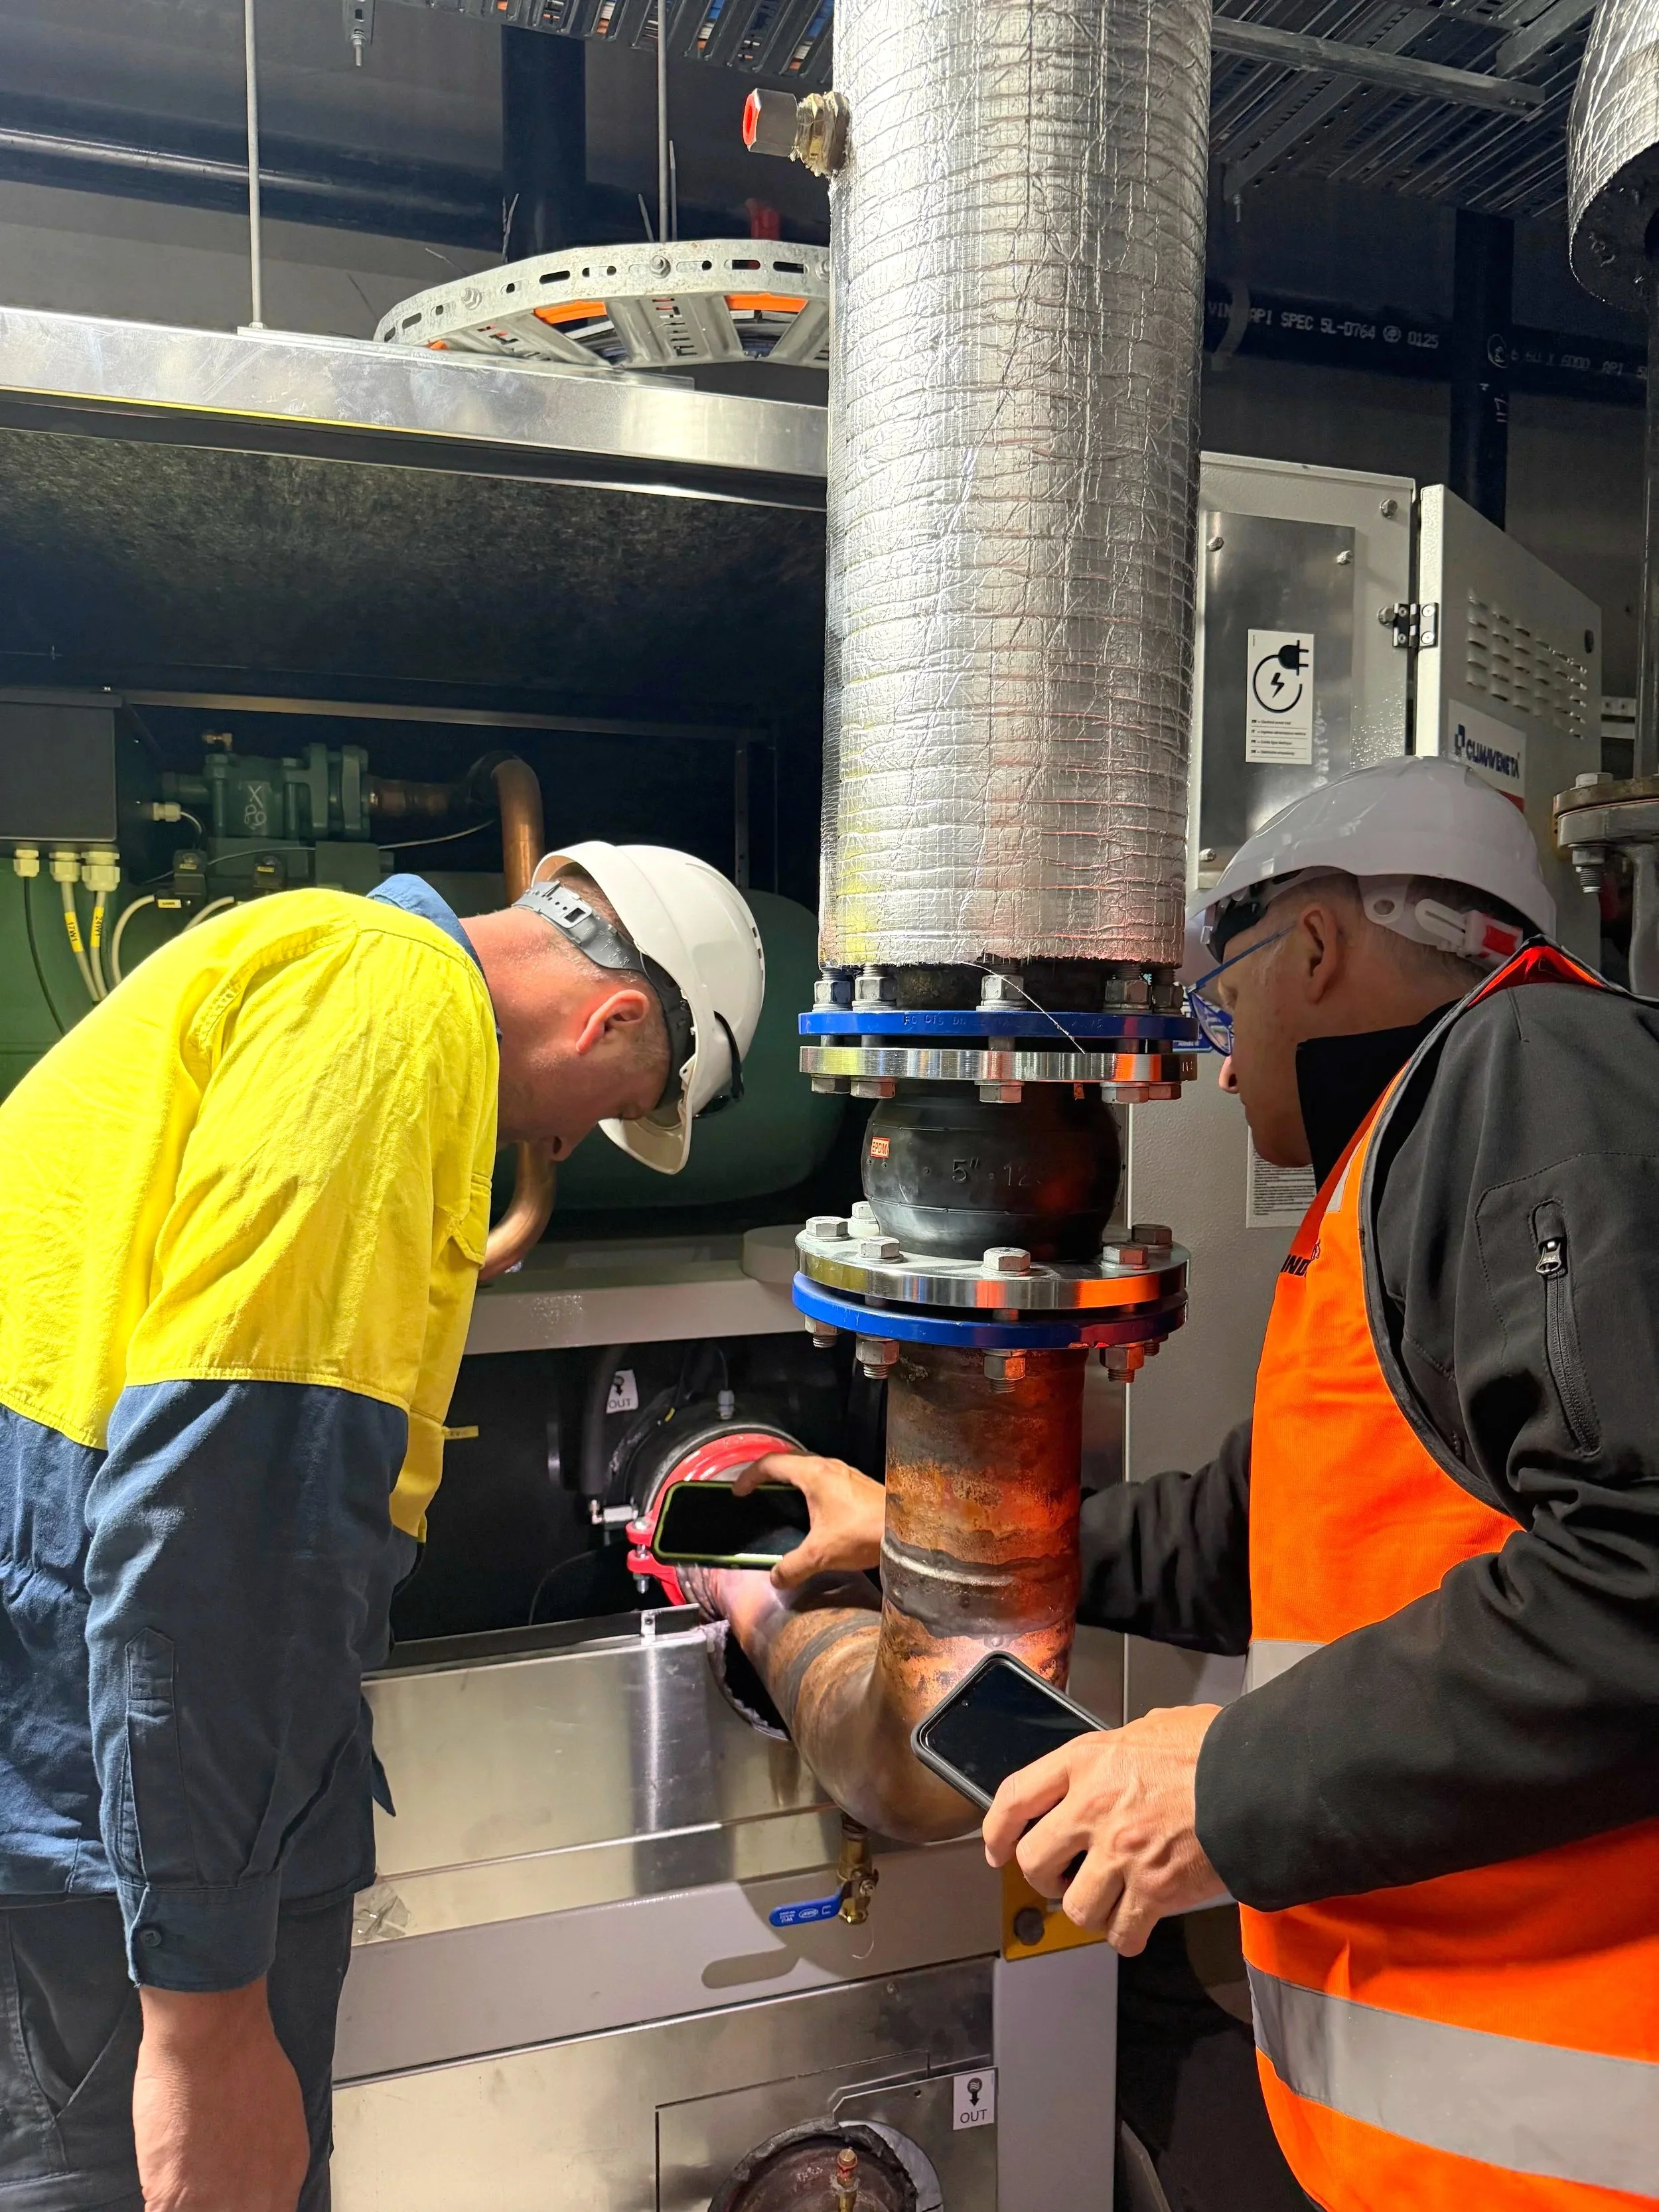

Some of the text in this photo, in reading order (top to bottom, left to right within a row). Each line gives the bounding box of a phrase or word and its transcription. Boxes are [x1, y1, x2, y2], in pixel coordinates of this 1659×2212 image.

[1280, 312, 1314, 331] SPEC
[1320, 318, 1376, 340] 5L-0764
[1407, 331, 1440, 349] 0125
[67, 921, 78, 942] 17W1
[872, 1142, 887, 1155] EPDM
[609, 1398, 631, 1409] OUT
[960, 2108, 987, 2124] OUT
